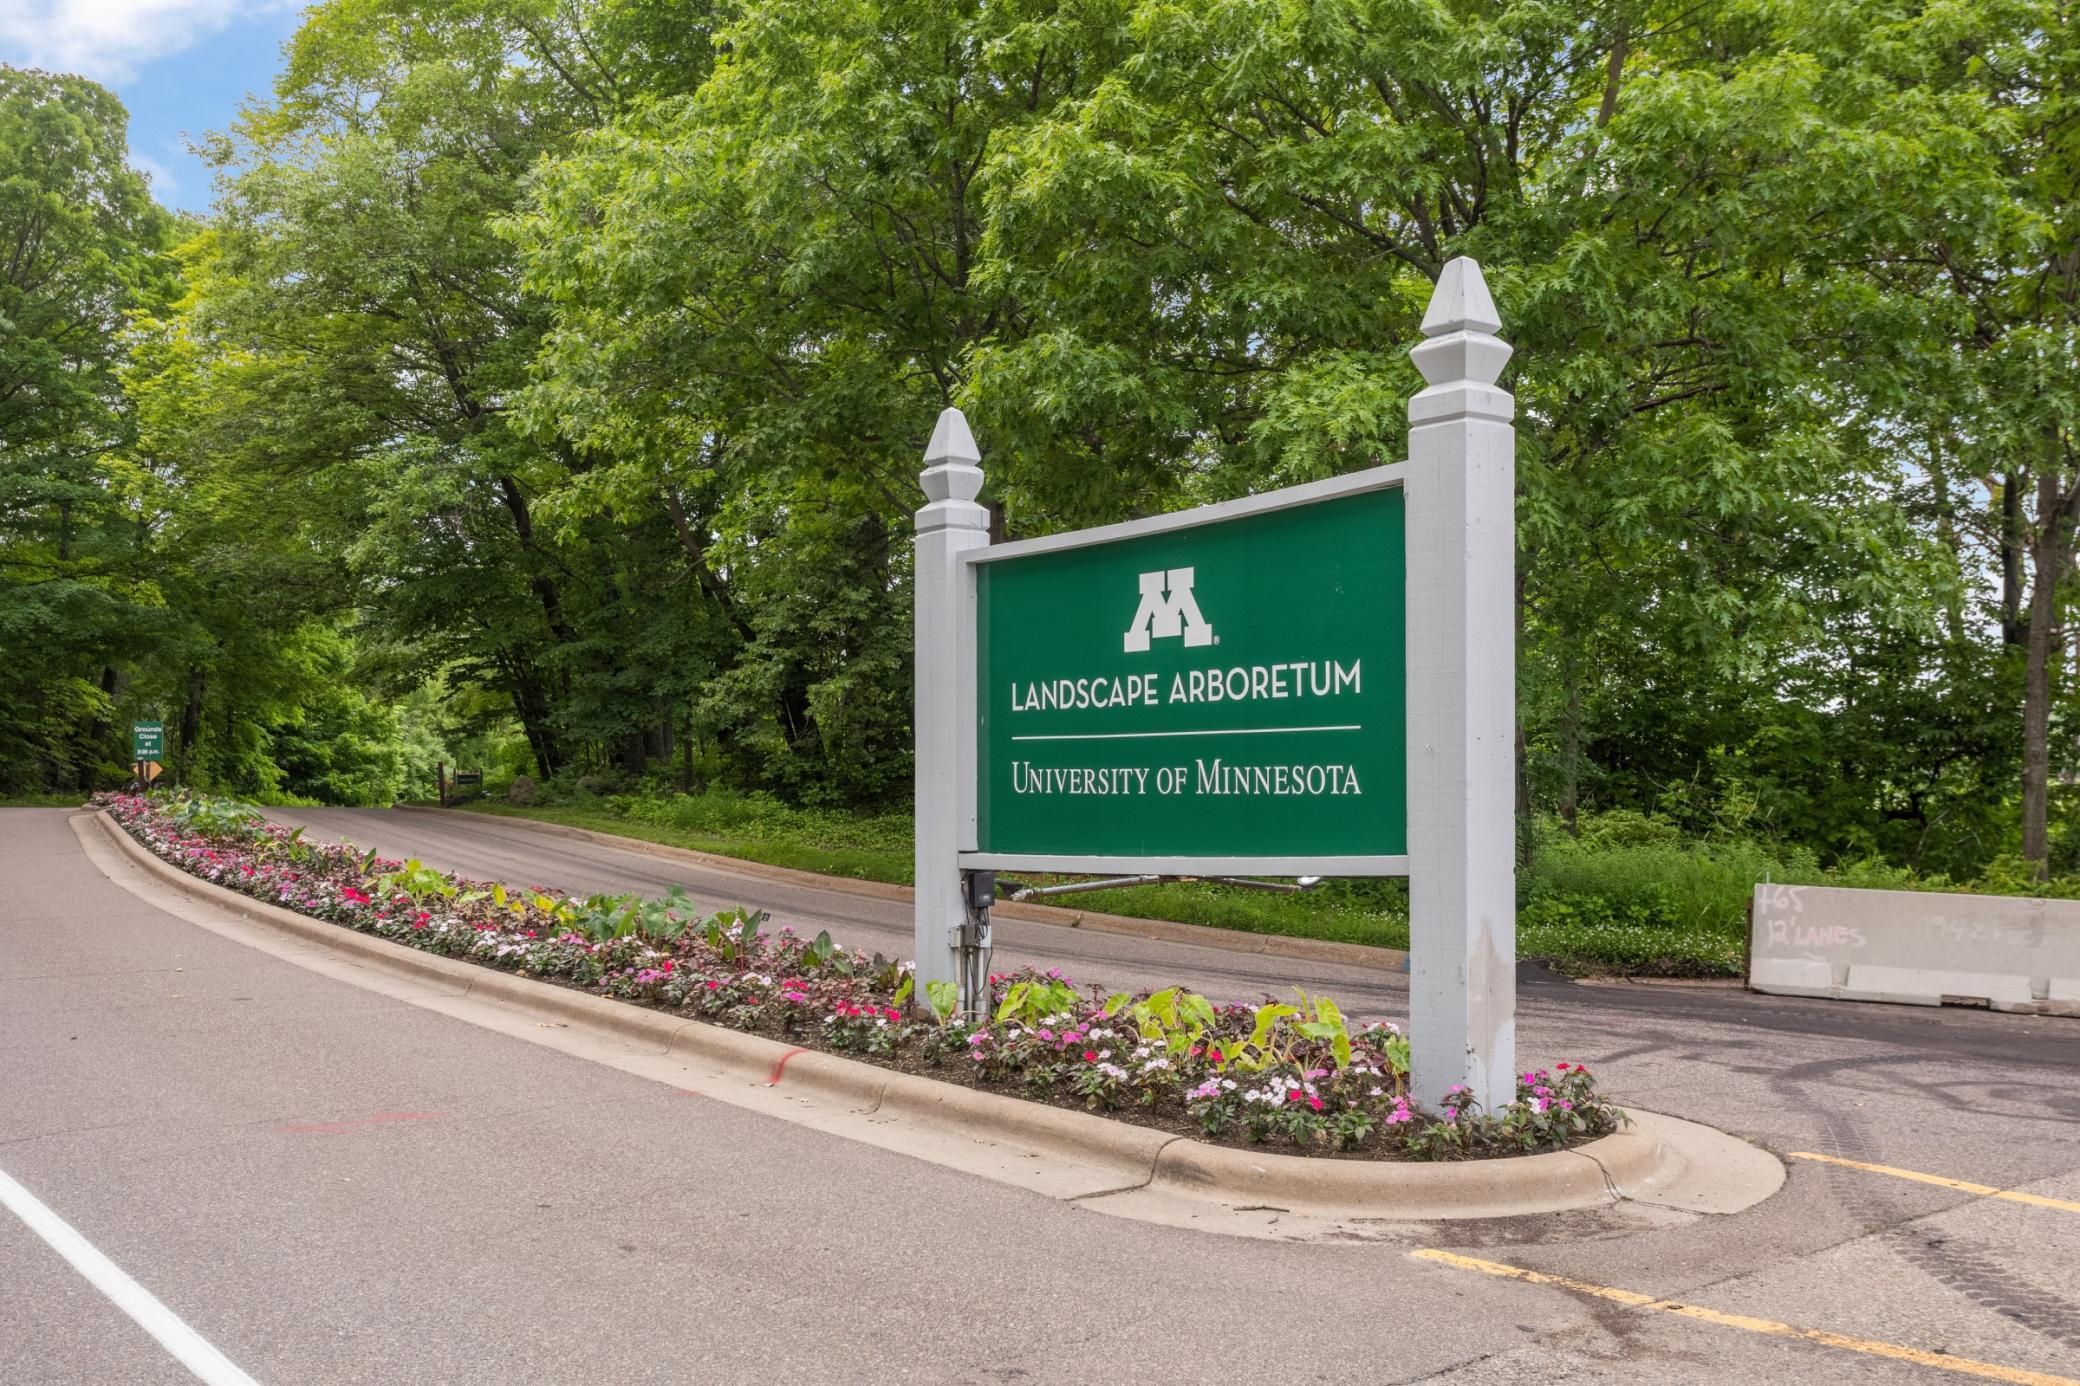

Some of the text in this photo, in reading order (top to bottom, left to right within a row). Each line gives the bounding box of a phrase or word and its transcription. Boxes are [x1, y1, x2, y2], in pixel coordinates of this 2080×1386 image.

[1011, 658, 1361, 712] LANDSCAPE ARBORETUM
[1011, 758, 1362, 796] UNIVERSITY OF MINNESOTA
[1795, 926, 1867, 948] LANES
